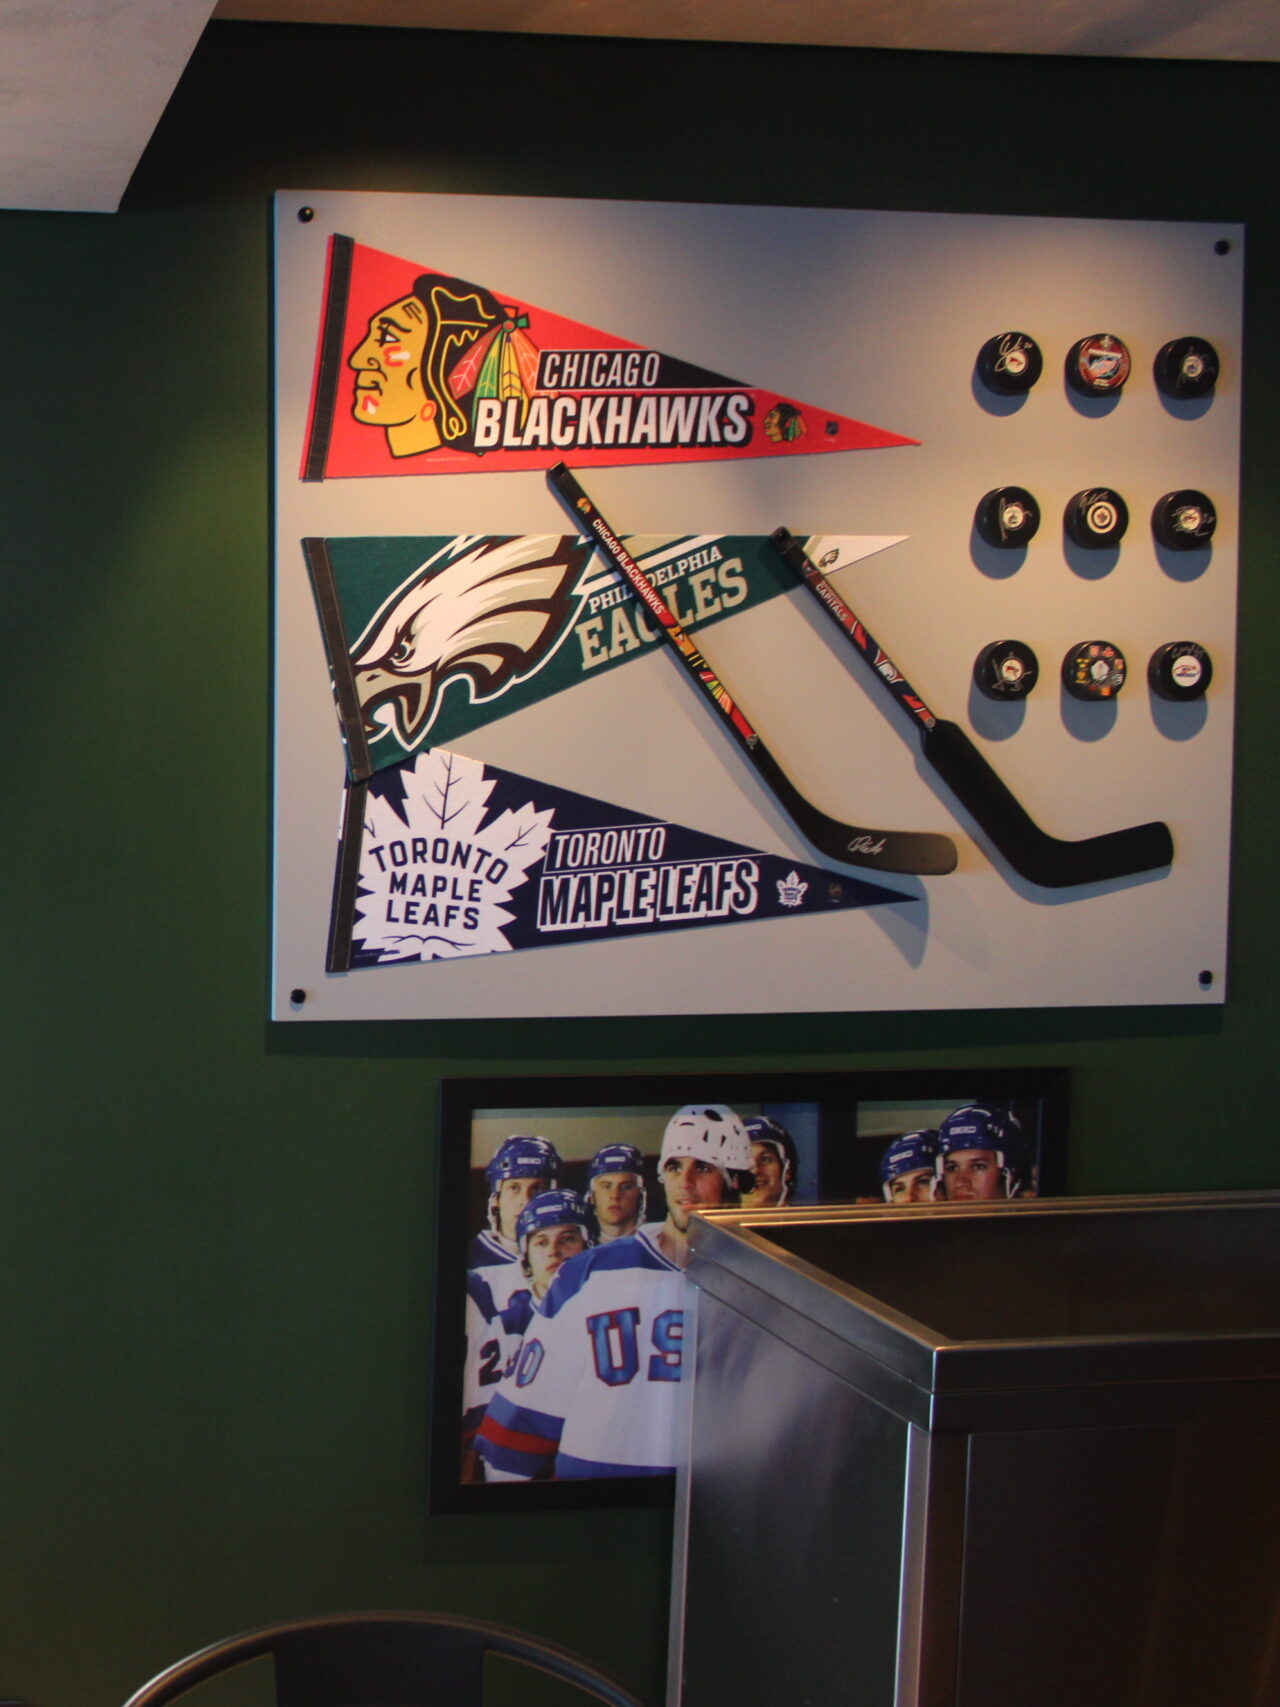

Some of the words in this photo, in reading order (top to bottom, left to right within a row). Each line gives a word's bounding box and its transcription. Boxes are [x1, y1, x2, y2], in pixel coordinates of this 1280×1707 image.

[542, 352, 661, 388] CHICAGO
[473, 393, 752, 448] BLACKHAWKS
[588, 545, 724, 616] PHILDELPHIA
[592, 517, 621, 554] CHICAGO
[616, 550, 666, 615] BLACKHAWKS
[815, 582, 849, 622] CAPITALS
[368, 837, 509, 885] TORONTO
[554, 826, 667, 869] TORONTO
[388, 871, 484, 903] MAPLE
[537, 867, 657, 932] MAPLE
[655, 858, 760, 923] LEAFS
[385, 899, 480, 931] LEAFS
